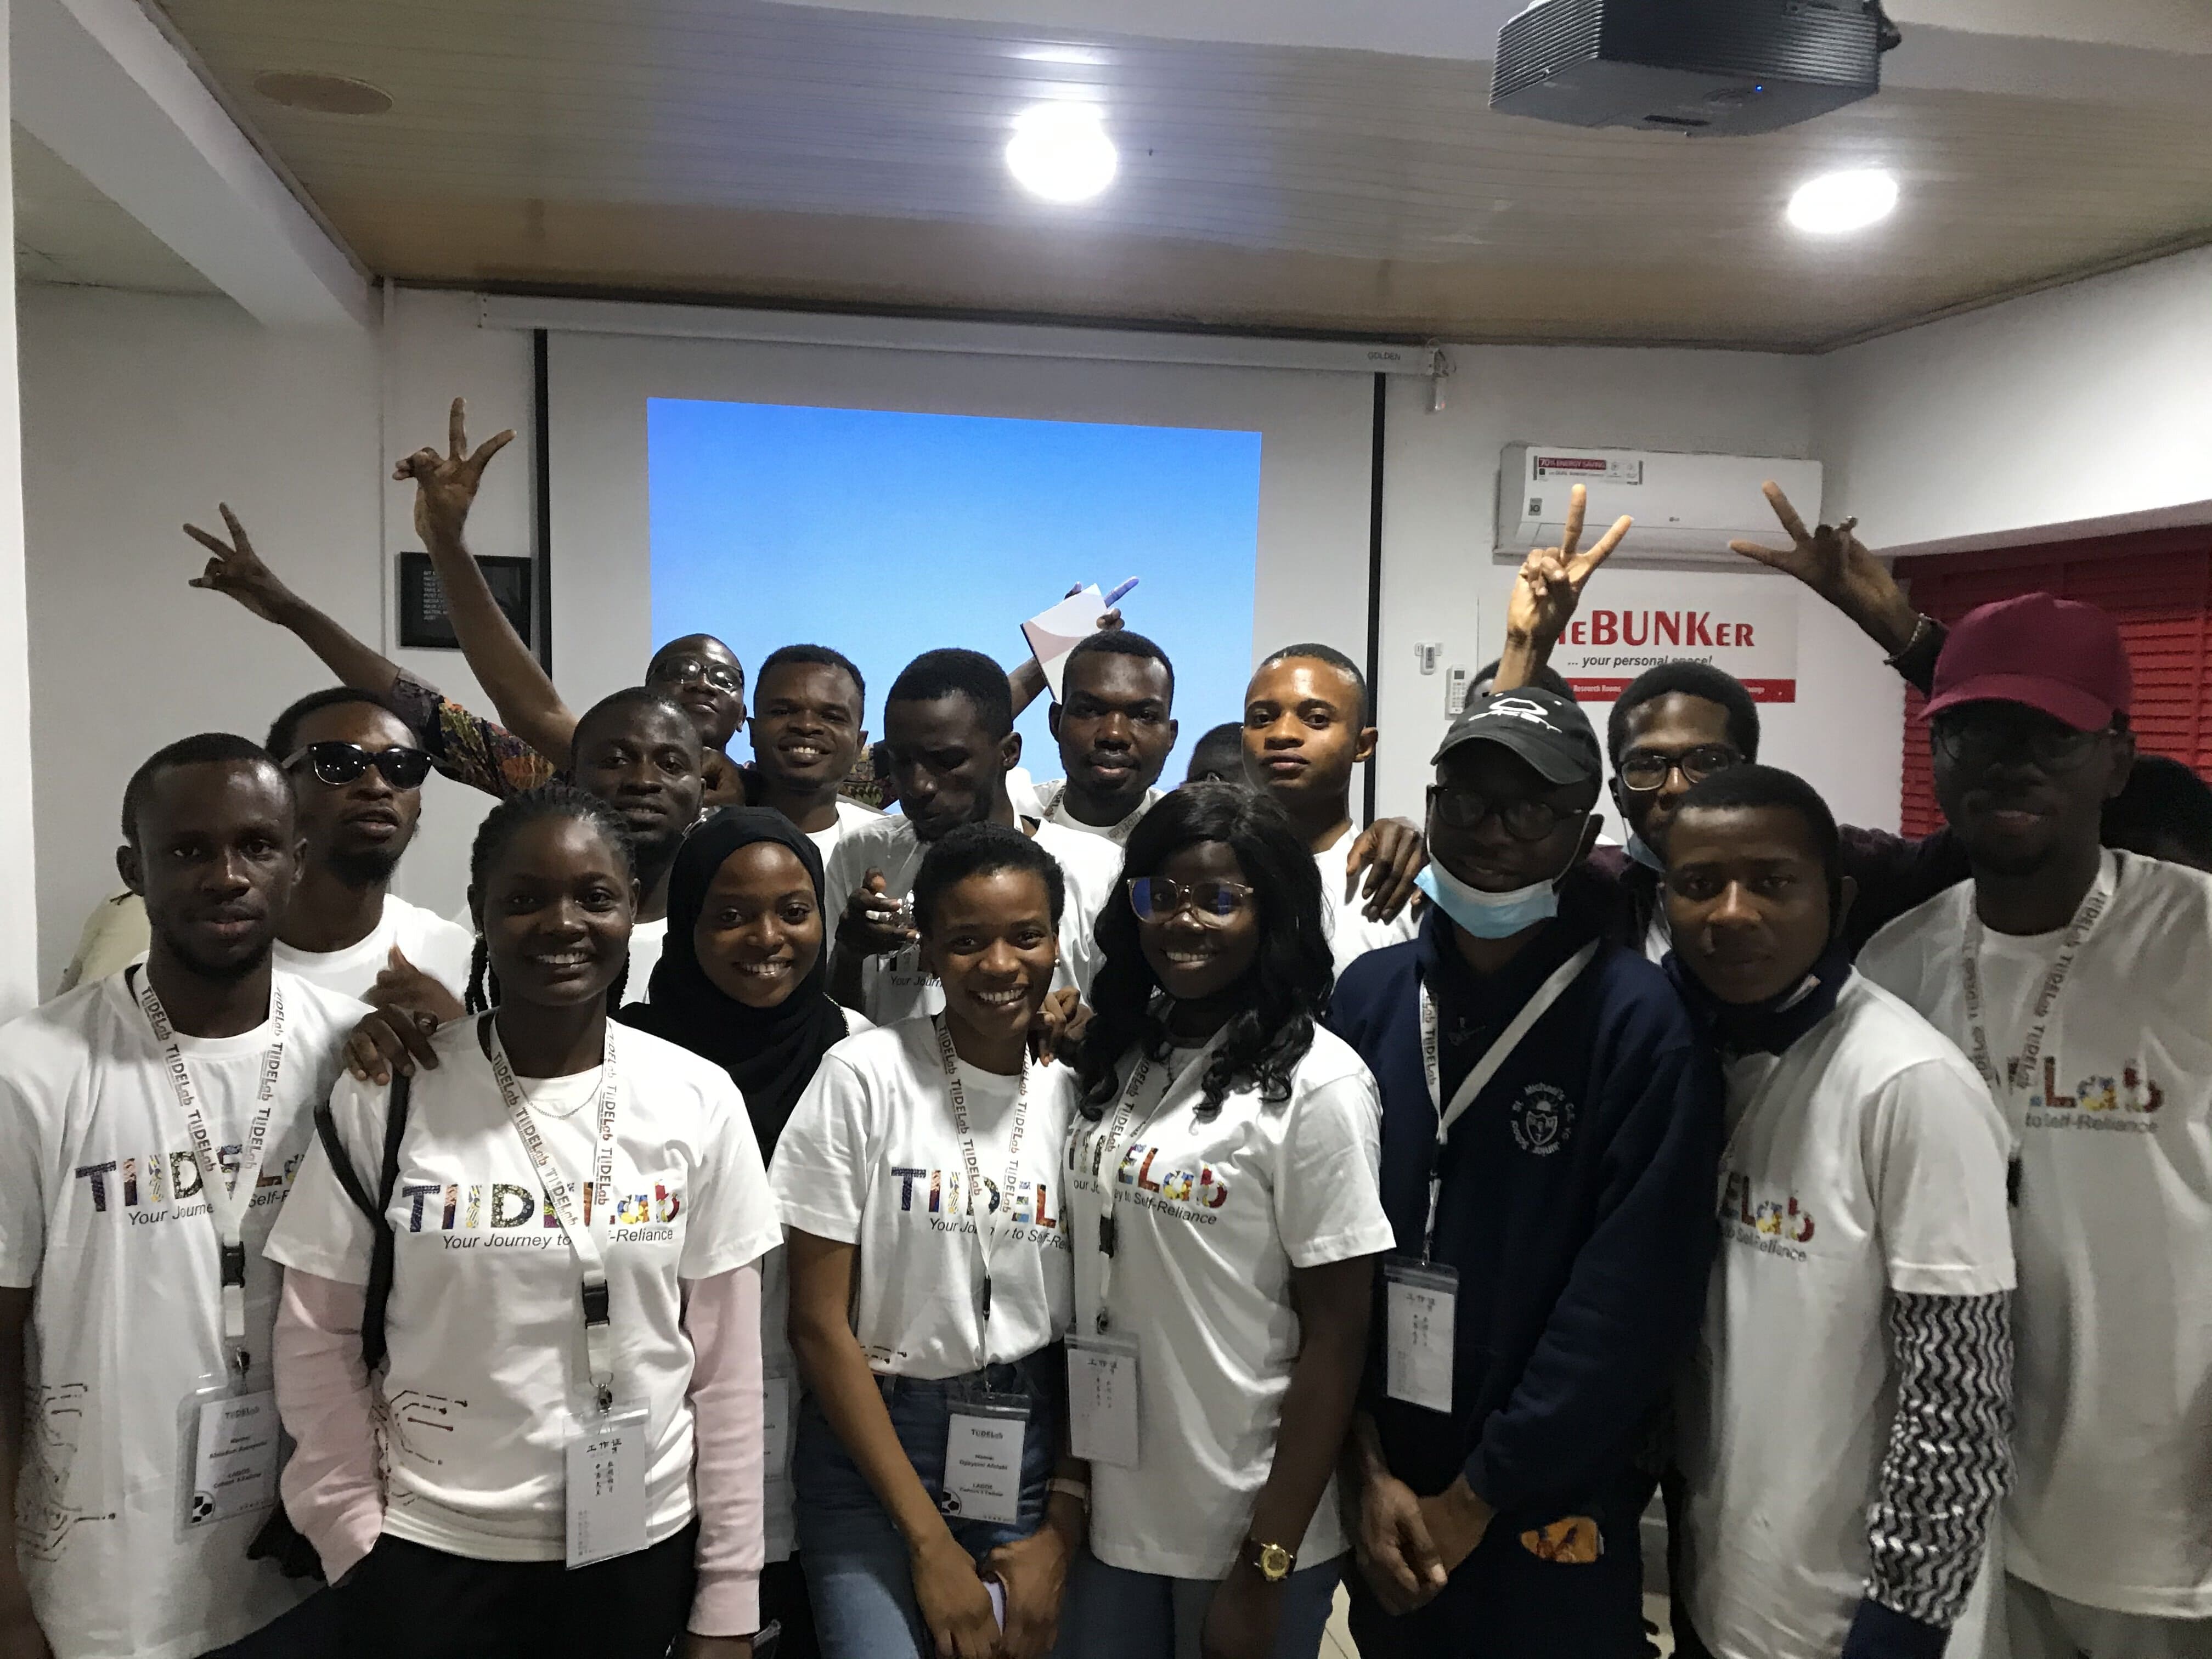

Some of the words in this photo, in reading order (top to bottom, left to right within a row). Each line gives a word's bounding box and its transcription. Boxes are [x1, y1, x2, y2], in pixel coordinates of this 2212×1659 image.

[1368, 352, 1401, 360] GOLDEN
[1582, 656, 1611, 668] your
[1613, 655, 1668, 667] personal
[890, 975, 911, 986] Your
[913, 976, 943, 988] Journ
[142, 986, 173, 1041] TIIDELab
[166, 1043, 196, 1106] TIIDELab
[261, 1042, 284, 1102] TIIDELab
[938, 1026, 958, 1075] TIIDELab
[1425, 1028, 1437, 1086] TIIDELab
[493, 1051, 520, 1106] TIIDELab
[602, 1086, 617, 1142] TIIDELab
[951, 1079, 970, 1135] TIIDELab
[1010, 1102, 1028, 1154] TIIDELab
[1106, 1102, 1135, 1152] TIIDELab
[188, 1109, 217, 1173] TIIDELab
[244, 1108, 271, 1170] TIIDELab
[515, 1107, 550, 1167] TIIDELab
[597, 1147, 613, 1206] TIIDELab
[963, 1138, 981, 1197] TIIDELab
[1002, 1160, 1019, 1214] TIIDELab
[1073, 1180, 1090, 1190] our
[128, 1210, 168, 1226] Your
[172, 1203, 215, 1220] Journe
[443, 1234, 479, 1250] Your
[484, 1234, 550, 1250] Journey
[557, 1234, 572, 1246] to
[930, 1217, 960, 1232] Your
[1012, 1227, 1025, 1240] to
